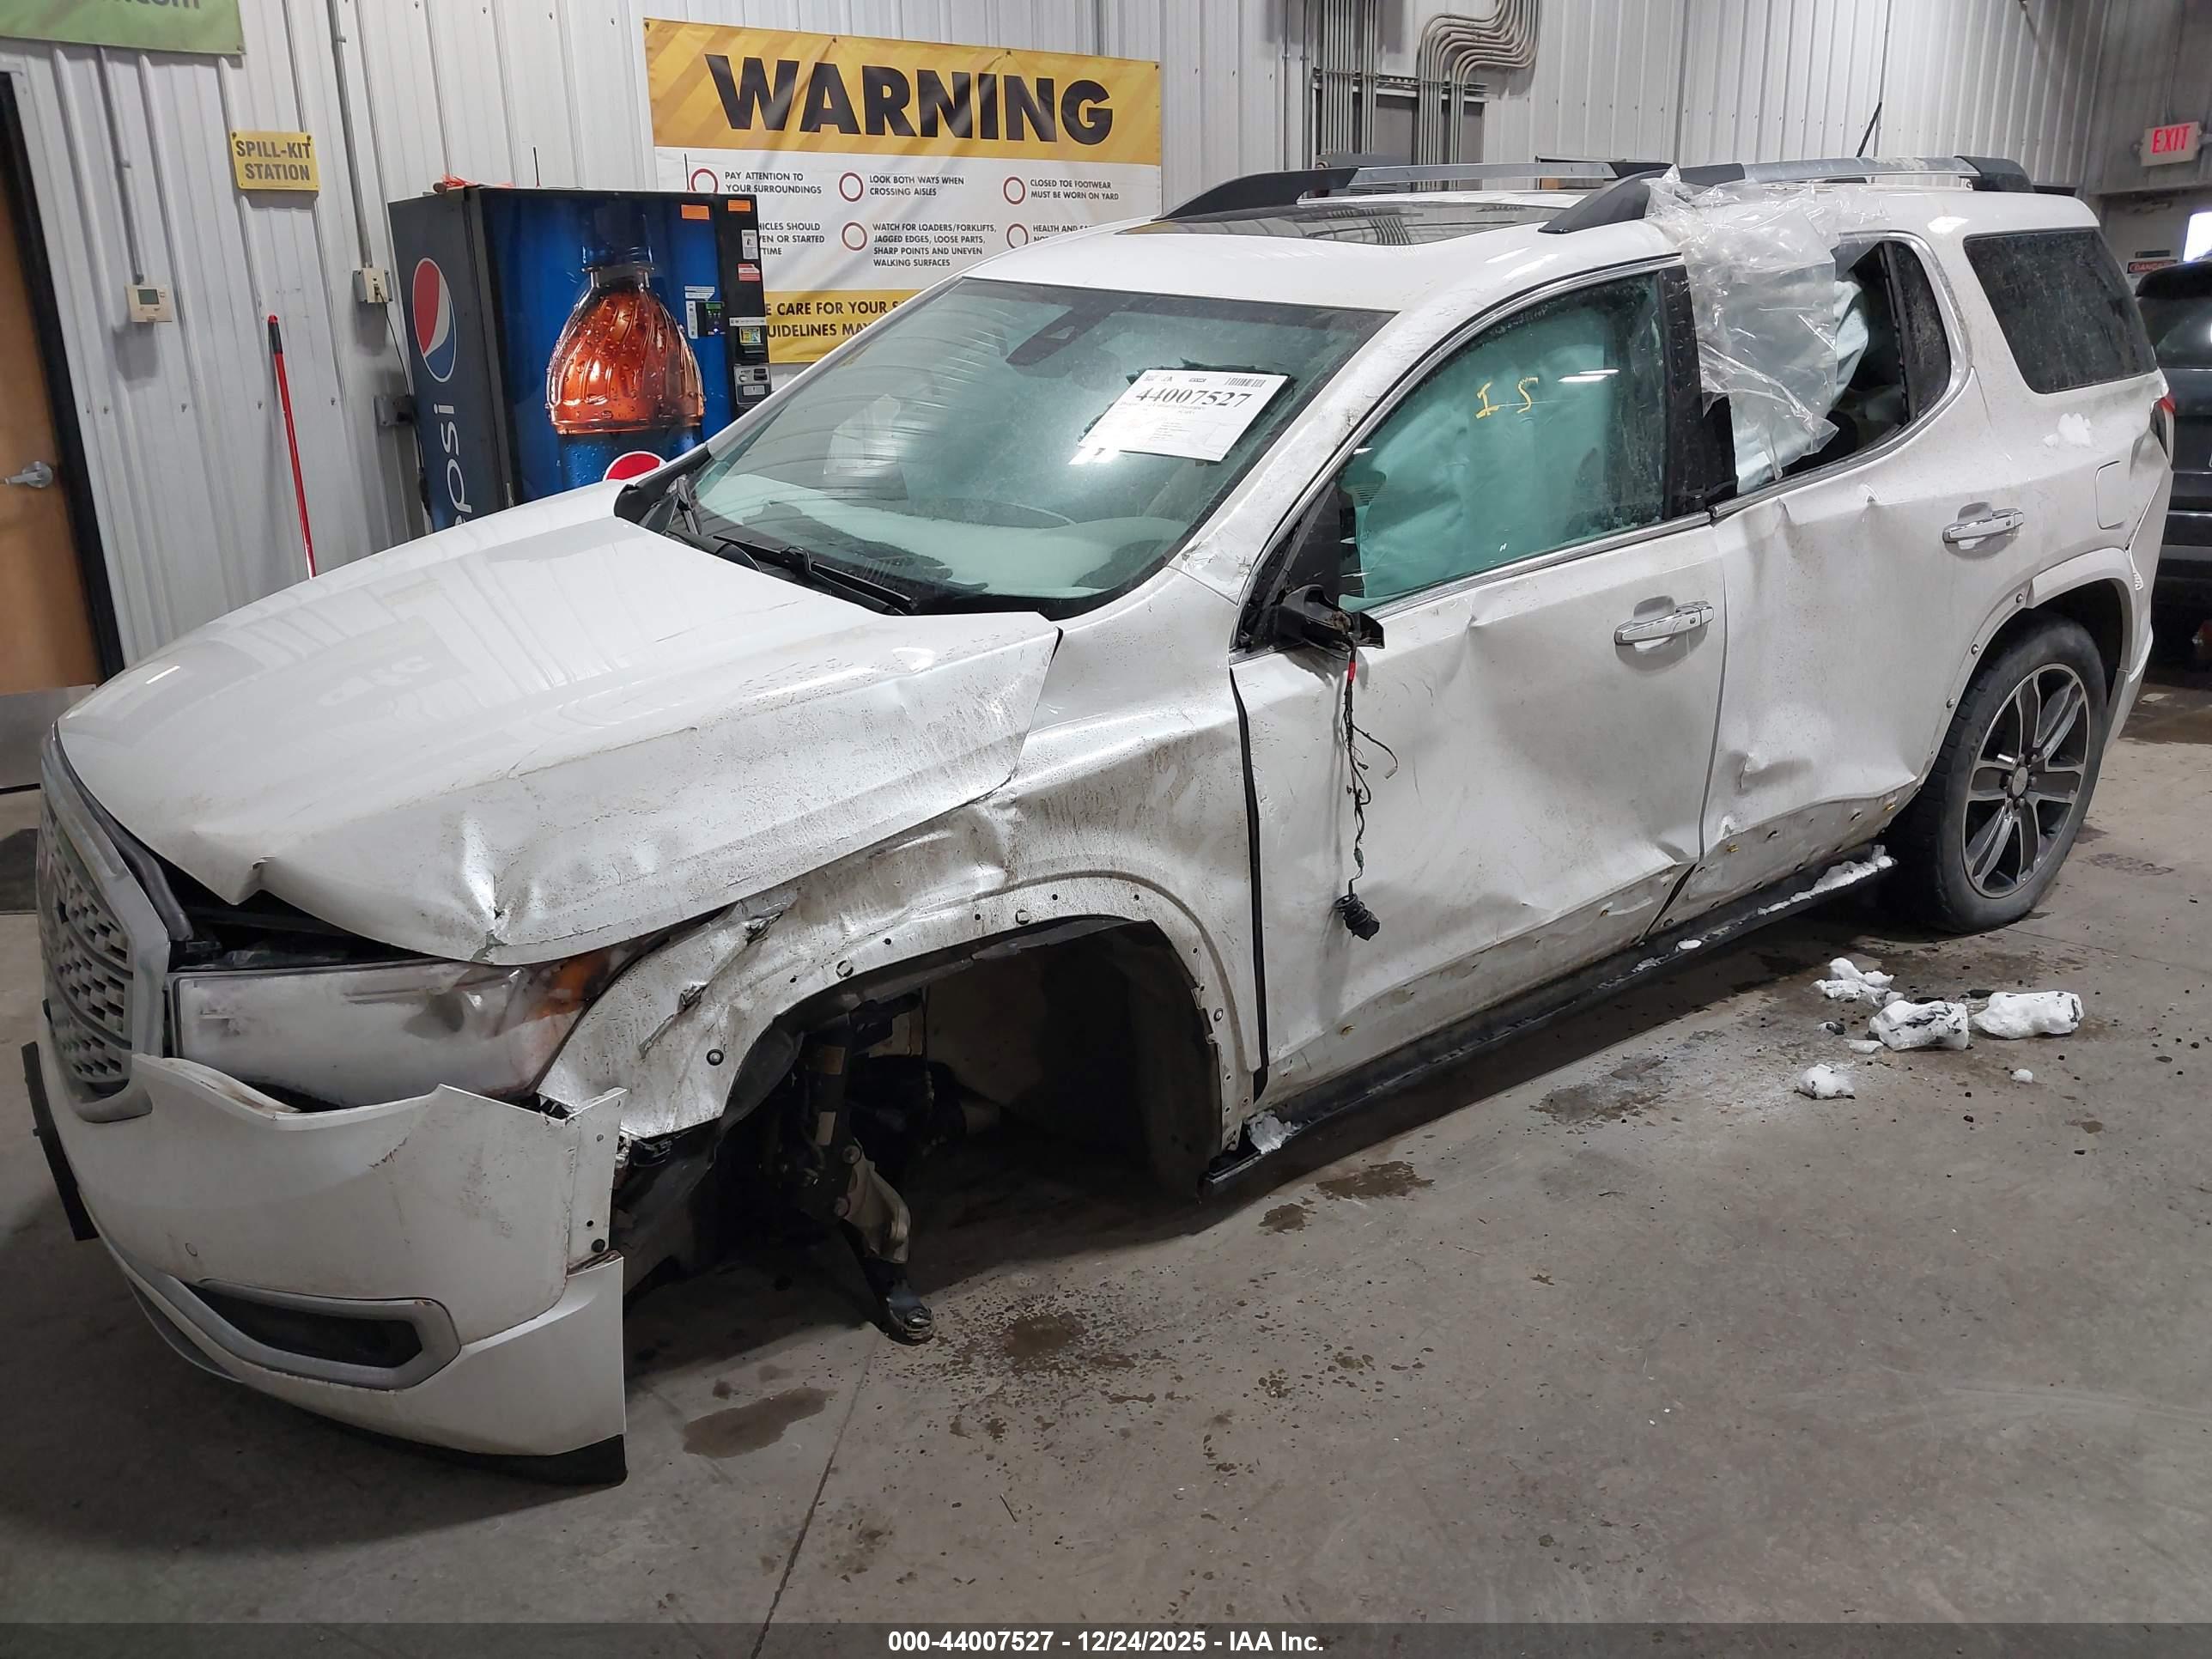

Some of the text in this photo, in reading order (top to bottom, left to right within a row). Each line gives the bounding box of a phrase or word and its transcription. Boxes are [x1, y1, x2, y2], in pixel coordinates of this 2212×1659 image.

[704, 52, 1113, 145] WARNING
[2152, 125, 2191, 153] EXIT
[235, 140, 311, 159] SPILL-KIT
[245, 163, 310, 180] STATION
[725, 171, 804, 181] PAY ATTENTION TO
[869, 175, 890, 184] LOOK
[917, 176, 939, 185] WAYS
[1030, 179, 1057, 187] CLOSED
[1074, 180, 1111, 189] FOOTWEAR
[726, 184, 822, 194] YOUR SURROUNDINGS
[869, 187, 911, 196] CROSSING
[1030, 190, 1050, 198] MUST
[1088, 191, 1100, 200] ON
[787, 222, 821, 231] SHOULD
[918, 223, 997, 233] LOADERS/FORKLIFTS,
[905, 235, 932, 244] EDGES,
[961, 235, 986, 244] PARTS,
[776, 302, 811, 315] CARE
[817, 301, 844, 314] FOR
[848, 301, 887, 314] YOUR
[767, 323, 837, 337] UIDELINES
[1135, 386, 1254, 408] 44007527
